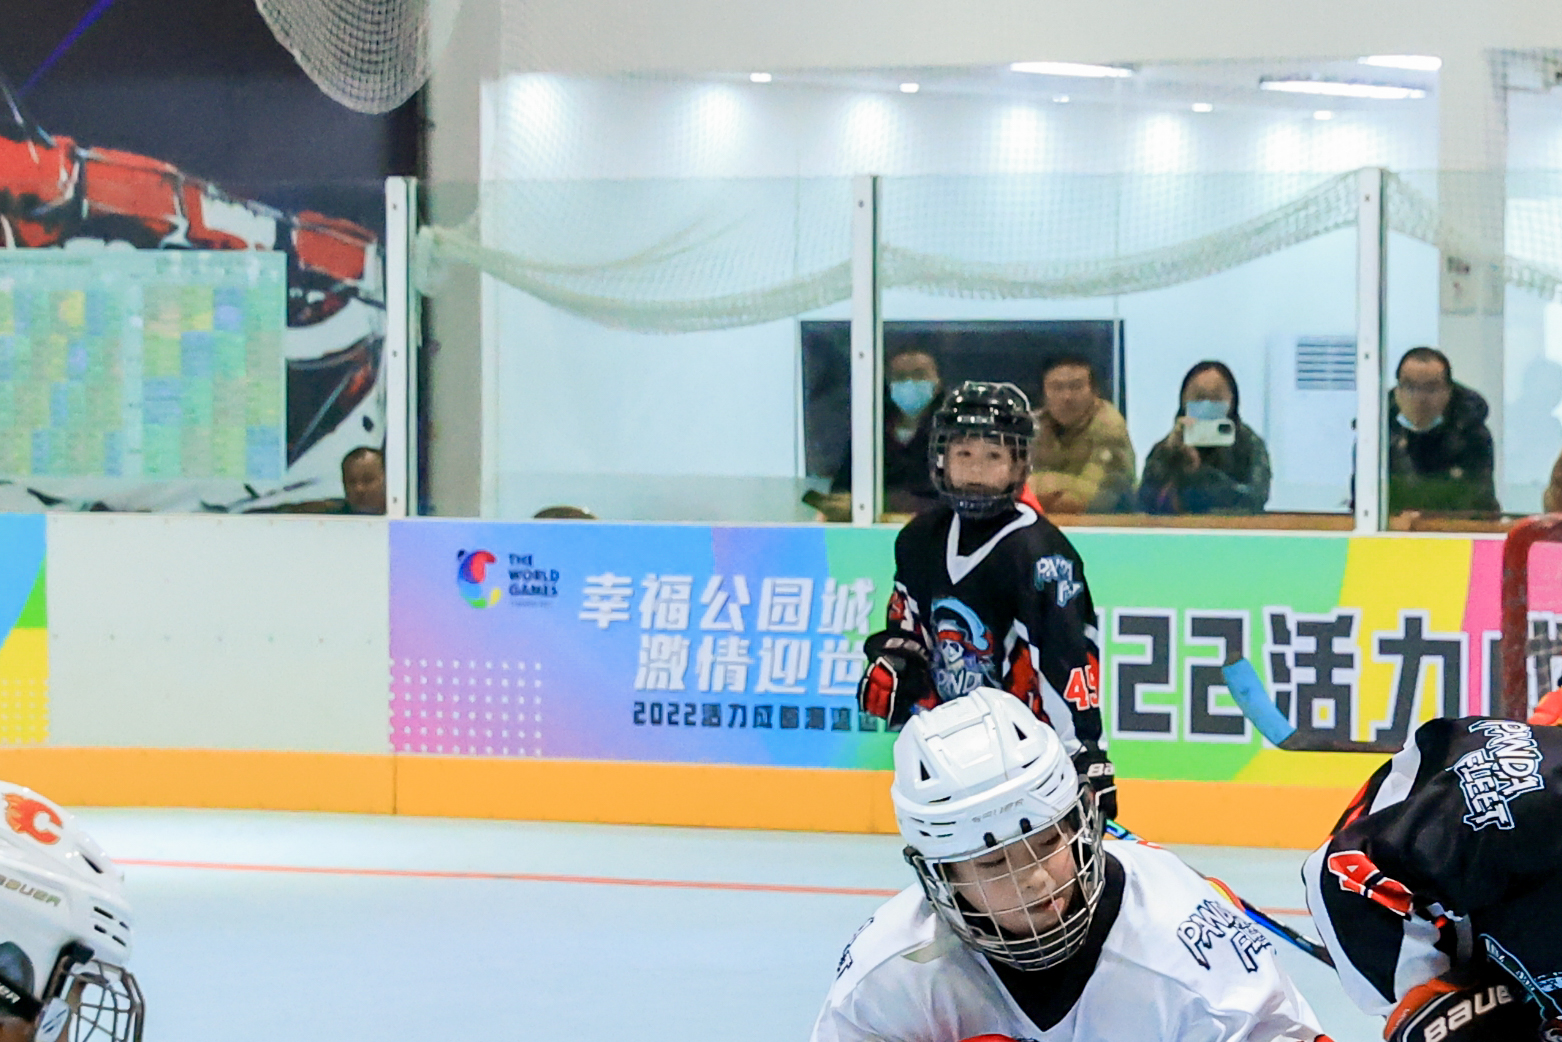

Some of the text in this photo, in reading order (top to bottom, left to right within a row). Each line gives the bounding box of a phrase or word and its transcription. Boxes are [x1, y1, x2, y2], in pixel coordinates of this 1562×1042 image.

[508, 568, 560, 583] WORLD
[508, 583, 559, 598] GAMES
[579, 573, 877, 635] 幸福公园城
[1453, 748, 1515, 831] FLEET
[1468, 720, 1545, 801] PANDA
